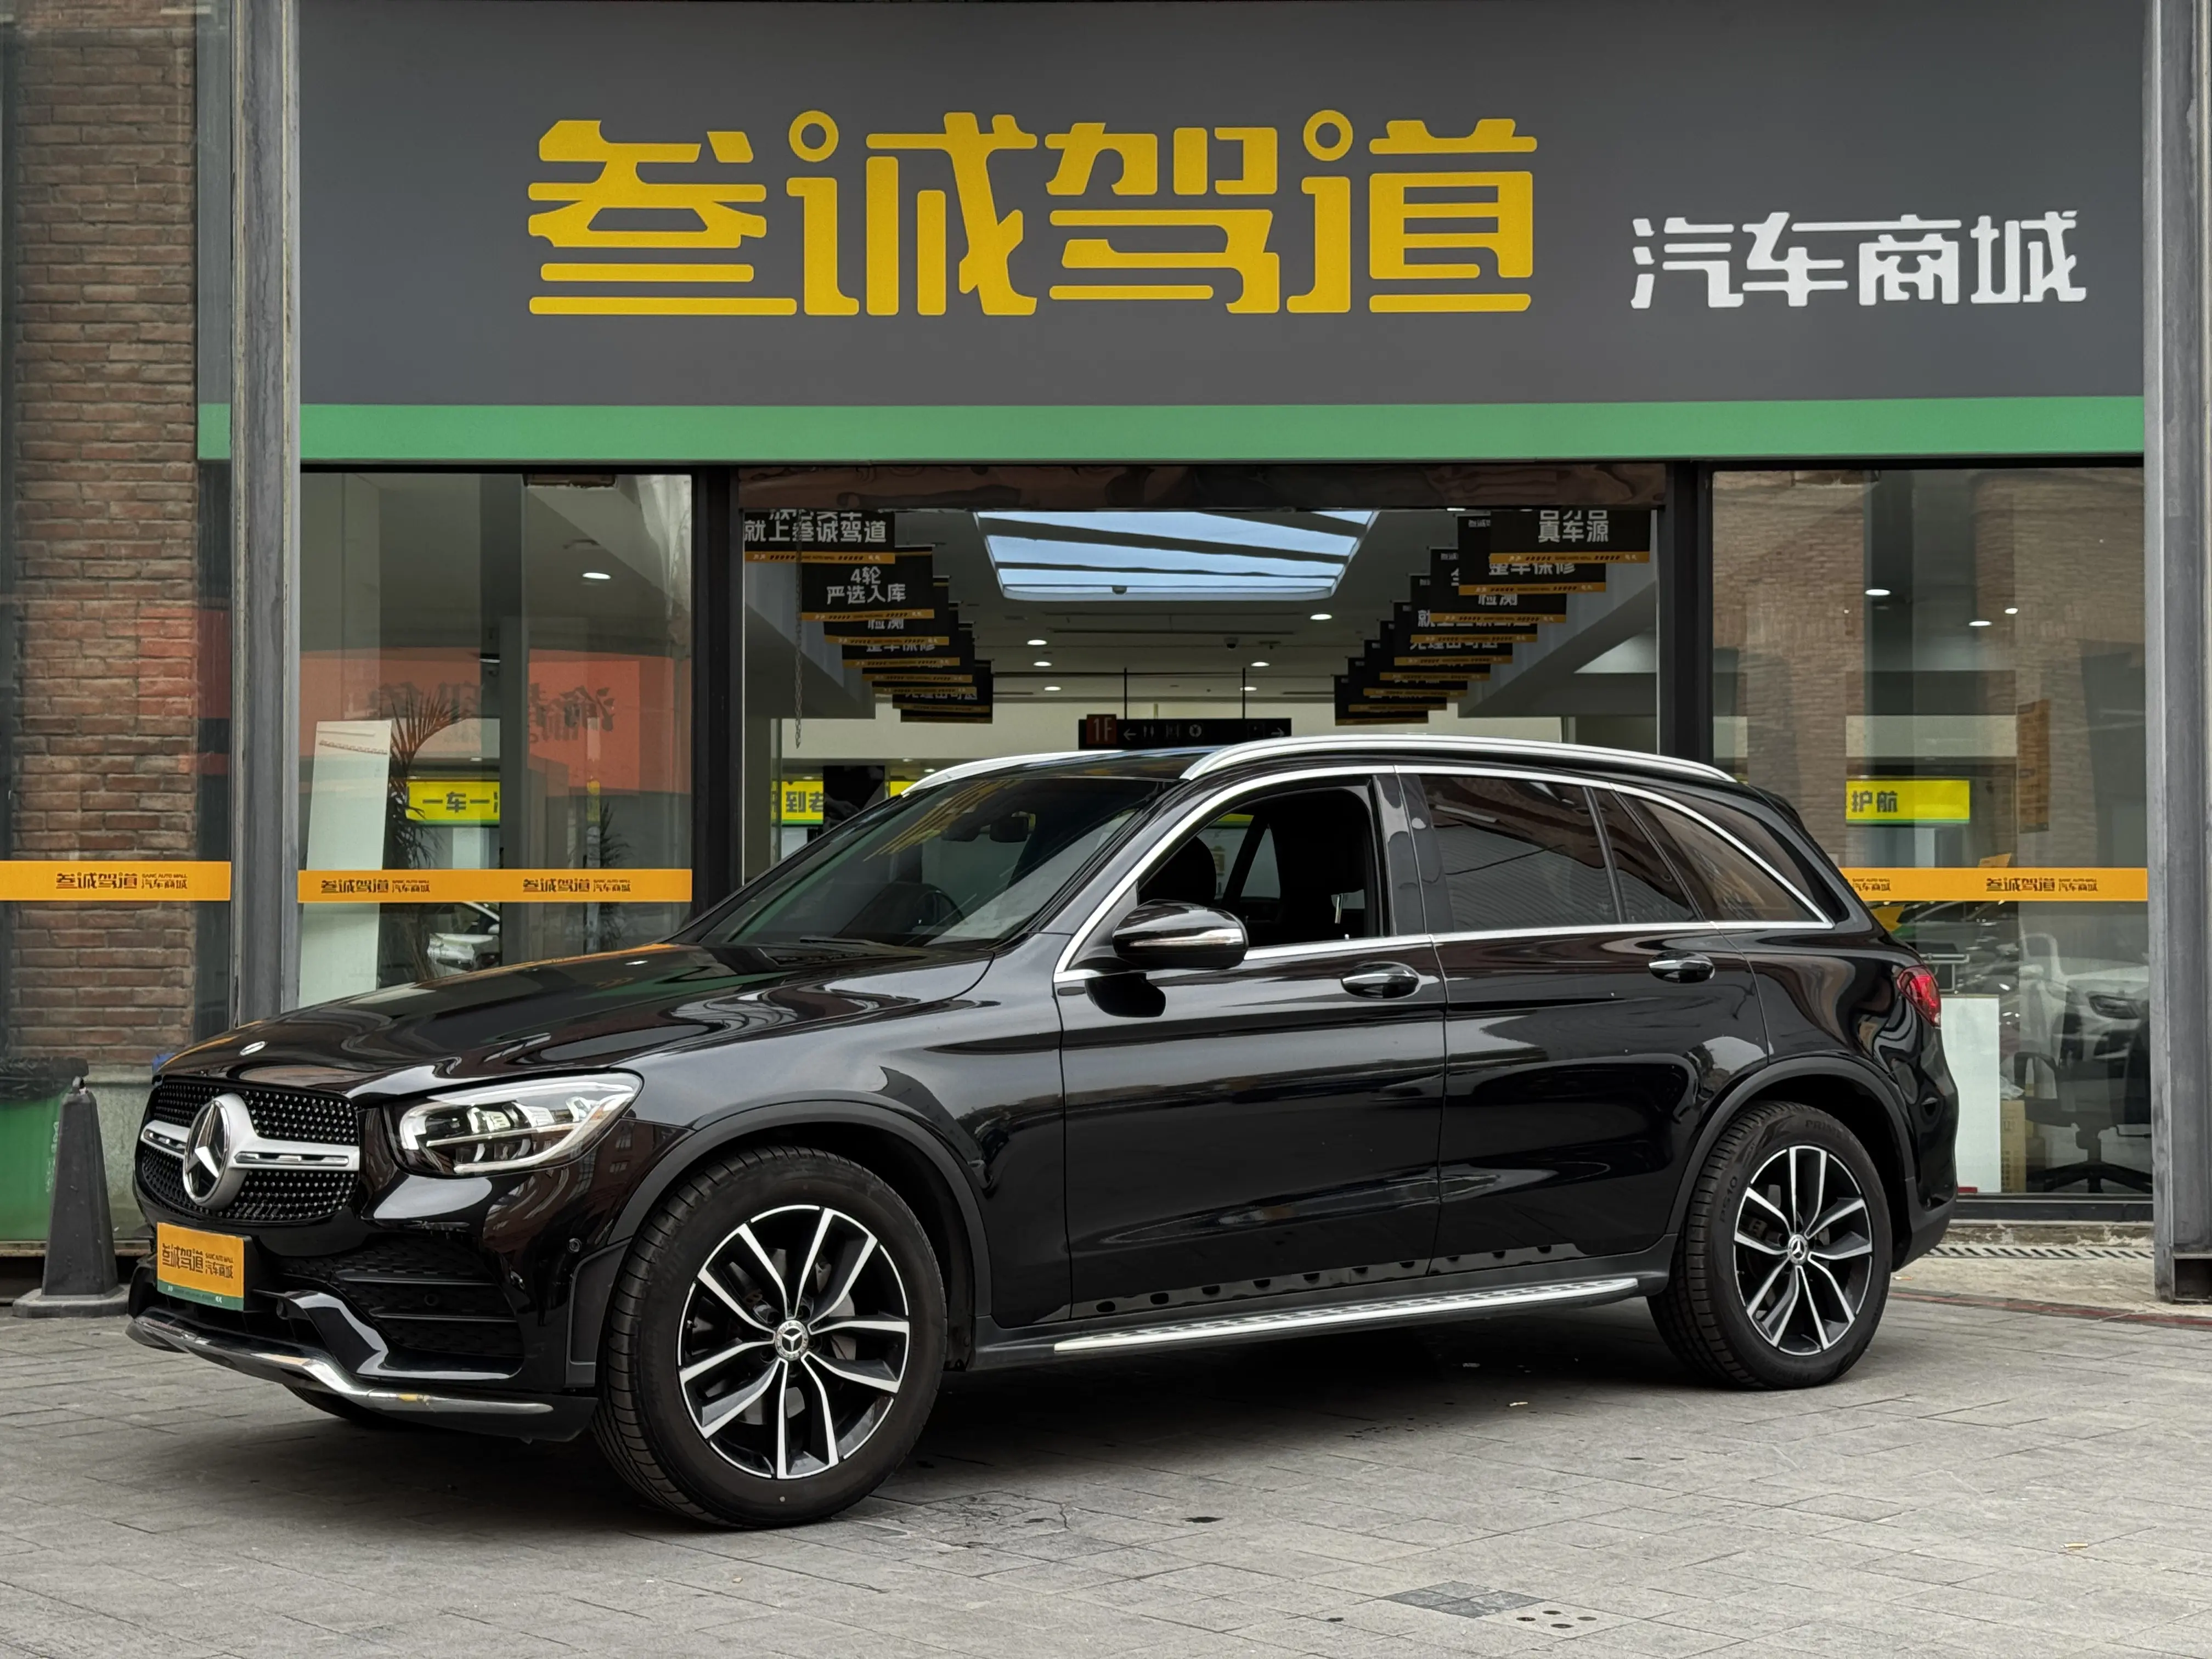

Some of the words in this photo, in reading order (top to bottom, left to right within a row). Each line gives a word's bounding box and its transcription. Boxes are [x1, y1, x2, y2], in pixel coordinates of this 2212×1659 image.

[1631, 211, 2086, 308] 汽车商城
[1538, 520, 1609, 543] 真车源
[851, 567, 881, 585] 4轮
[827, 584, 906, 605] 严选入库
[1093, 717, 1113, 742] 1F
[422, 791, 498, 813] 一车一
[1852, 790, 1898, 813] 护航
